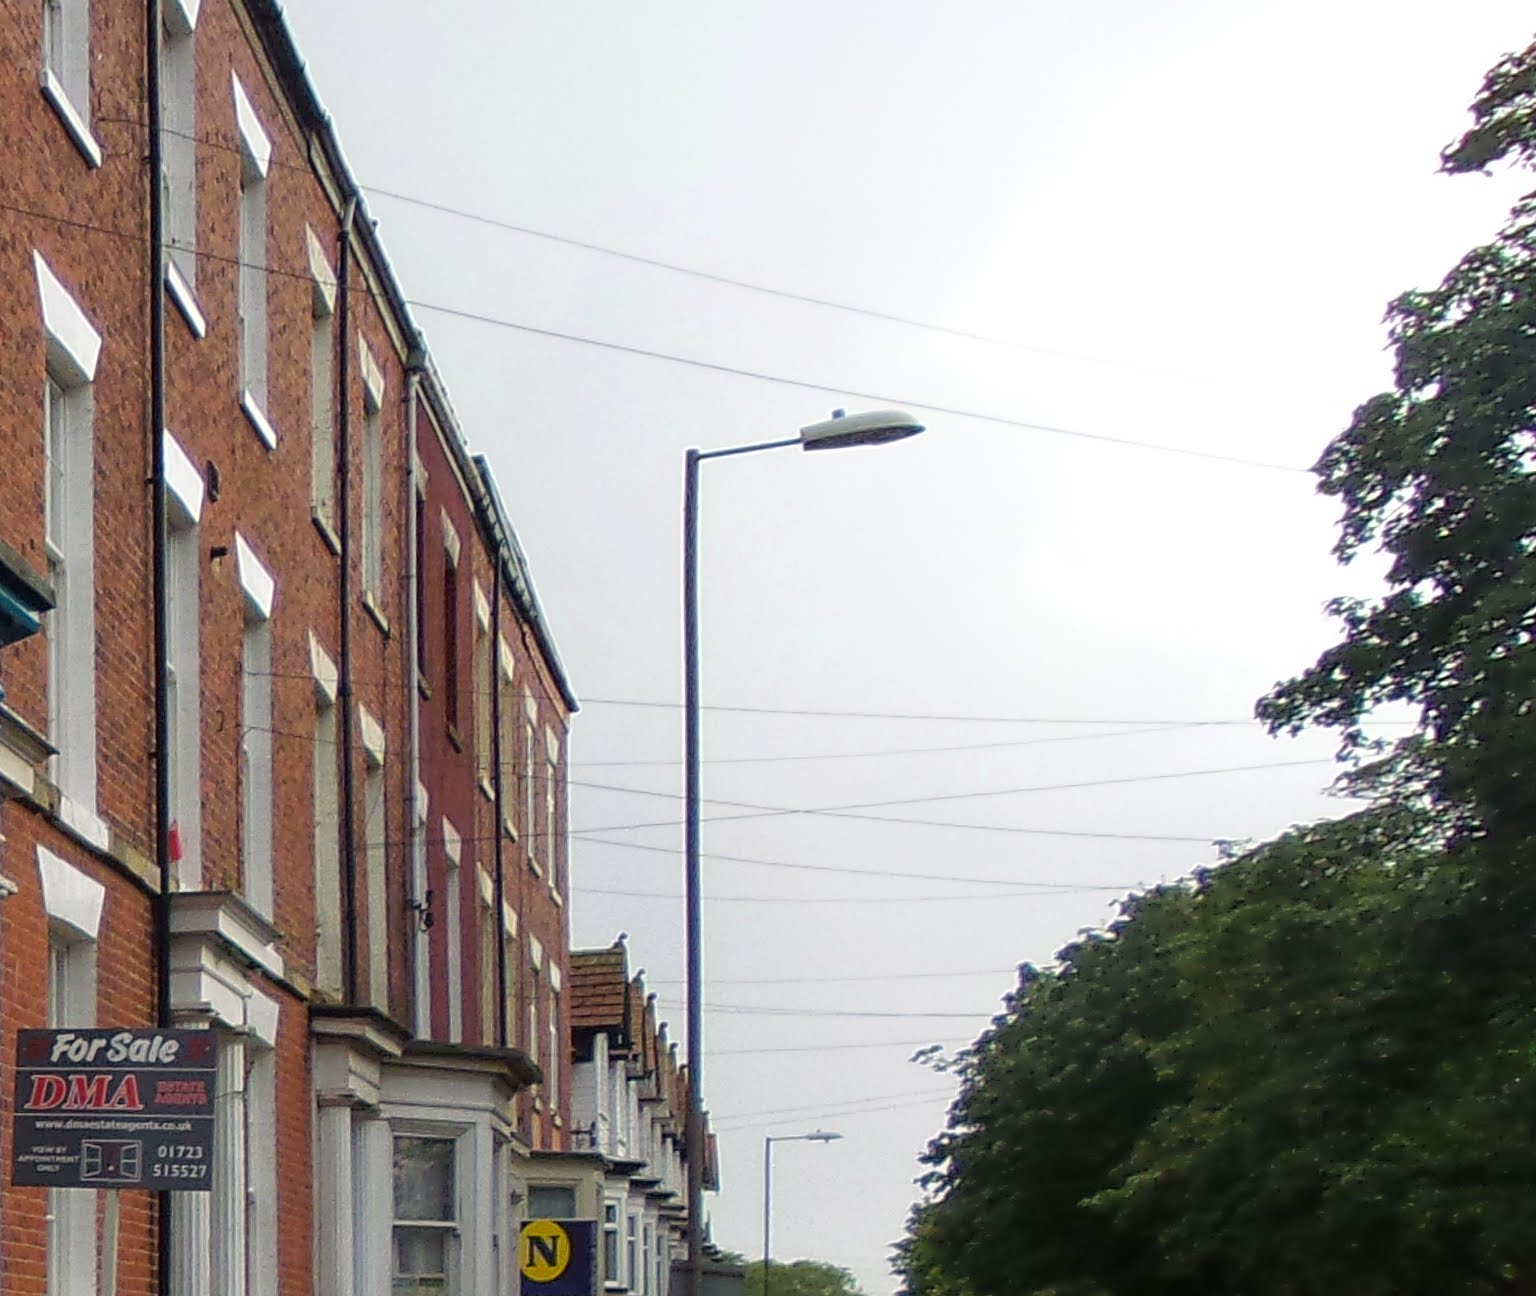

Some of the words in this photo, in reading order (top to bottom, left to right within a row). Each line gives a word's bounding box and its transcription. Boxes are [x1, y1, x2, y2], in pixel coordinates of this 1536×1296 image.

[50, 1034, 107, 1063] For
[106, 1032, 180, 1064] Sale
[24, 1073, 145, 1111] DMA
[158, 1145, 203, 1159] 01723
[152, 1164, 208, 1178] 515527
[525, 1235, 561, 1268] N
